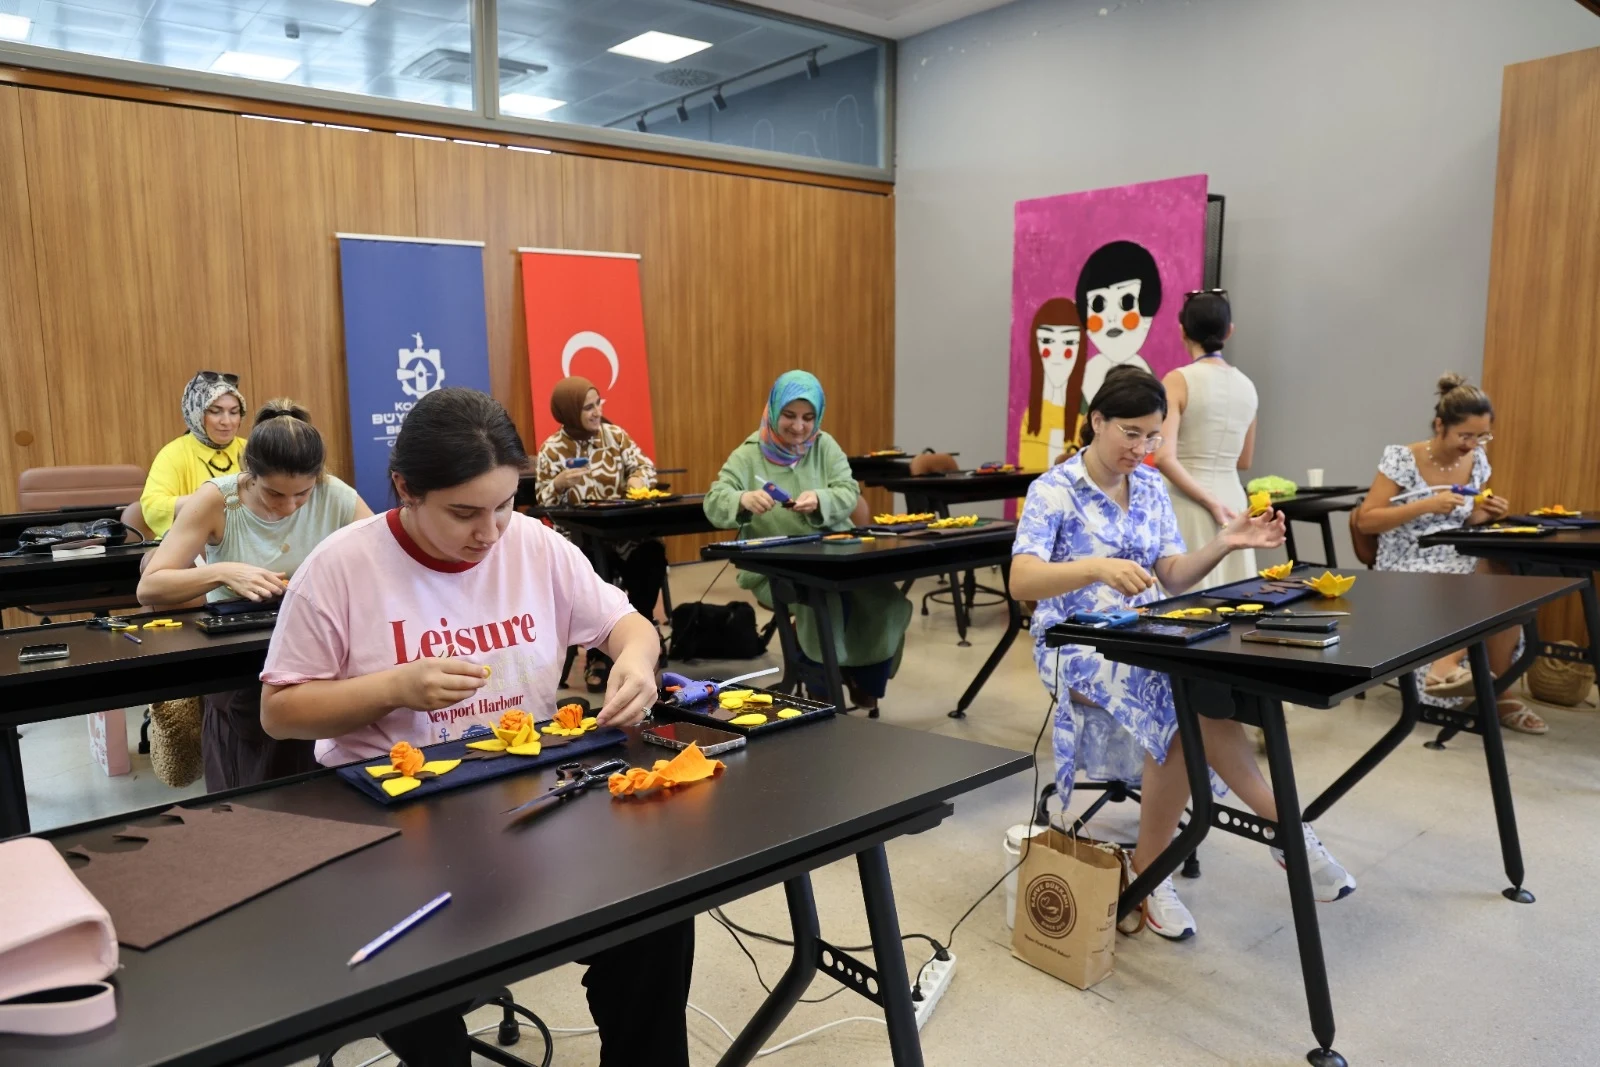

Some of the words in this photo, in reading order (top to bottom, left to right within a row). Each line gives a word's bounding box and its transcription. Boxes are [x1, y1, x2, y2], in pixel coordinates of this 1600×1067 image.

[388, 613, 537, 666] Leisure
[426, 703, 476, 724] Newport
[478, 693, 524, 714] Harbour
